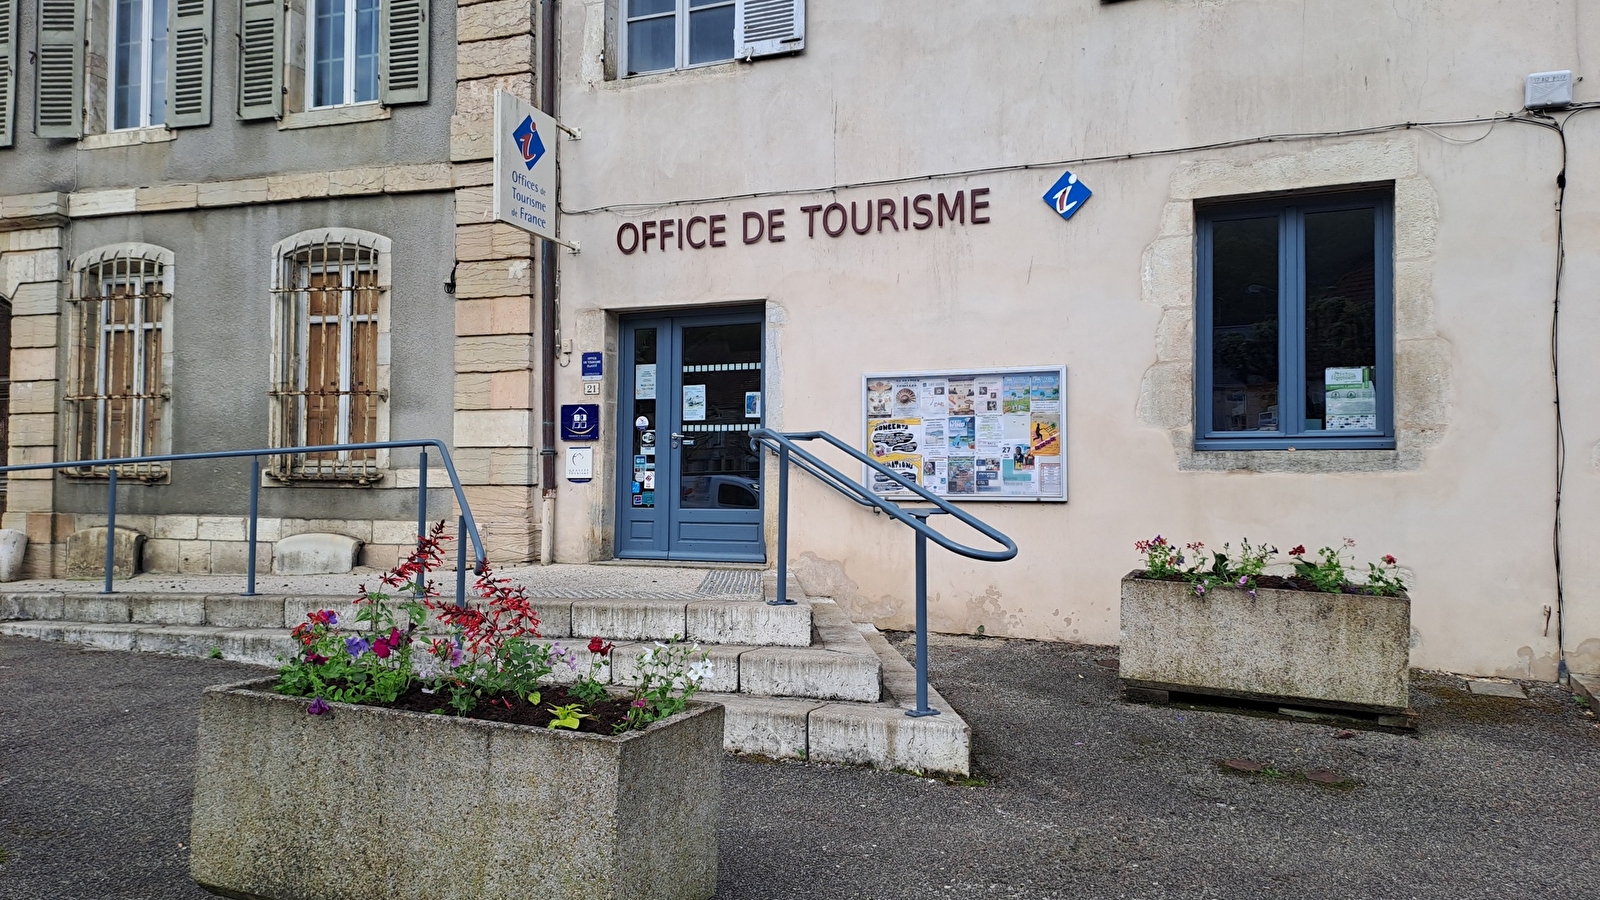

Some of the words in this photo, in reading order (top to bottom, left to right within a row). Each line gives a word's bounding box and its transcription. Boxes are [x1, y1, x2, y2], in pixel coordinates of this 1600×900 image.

[511, 170, 539, 193] Offices
[539, 186, 546, 196] de
[511, 187, 546, 212] Tourisme
[511, 207, 518, 218] de
[520, 207, 546, 229] France
[616, 213, 727, 255] OFFICE
[741, 208, 785, 246] DE
[800, 187, 991, 238] TOURISME
[587, 384, 596, 393] 21
